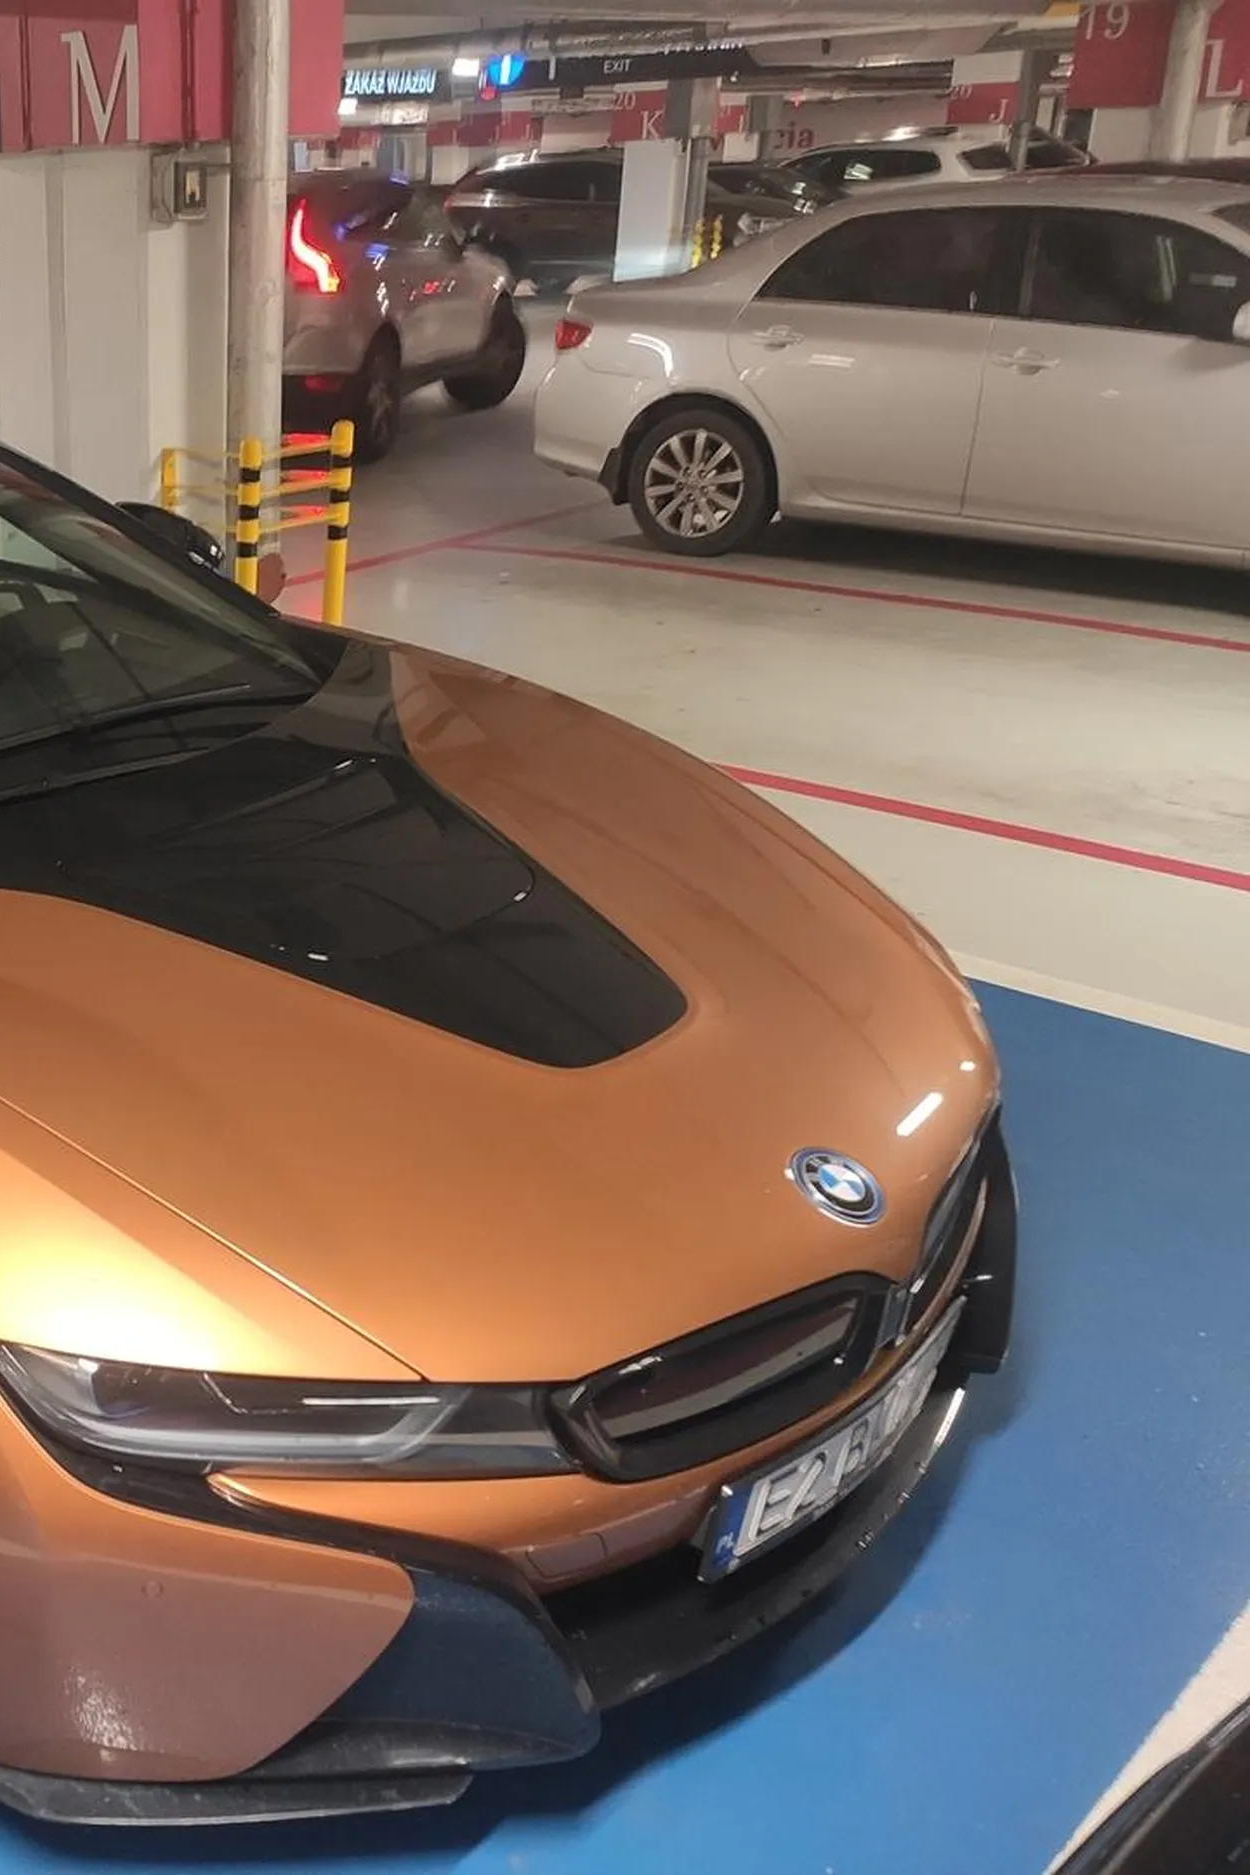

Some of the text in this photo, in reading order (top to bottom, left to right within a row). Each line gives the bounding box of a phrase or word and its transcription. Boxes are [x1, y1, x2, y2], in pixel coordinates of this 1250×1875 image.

[1080, 2, 1130, 40] 19
[60, 24, 141, 145] M
[603, 59, 632, 75] EXIT
[1204, 38, 1245, 98] L
[640, 110, 663, 140] K
